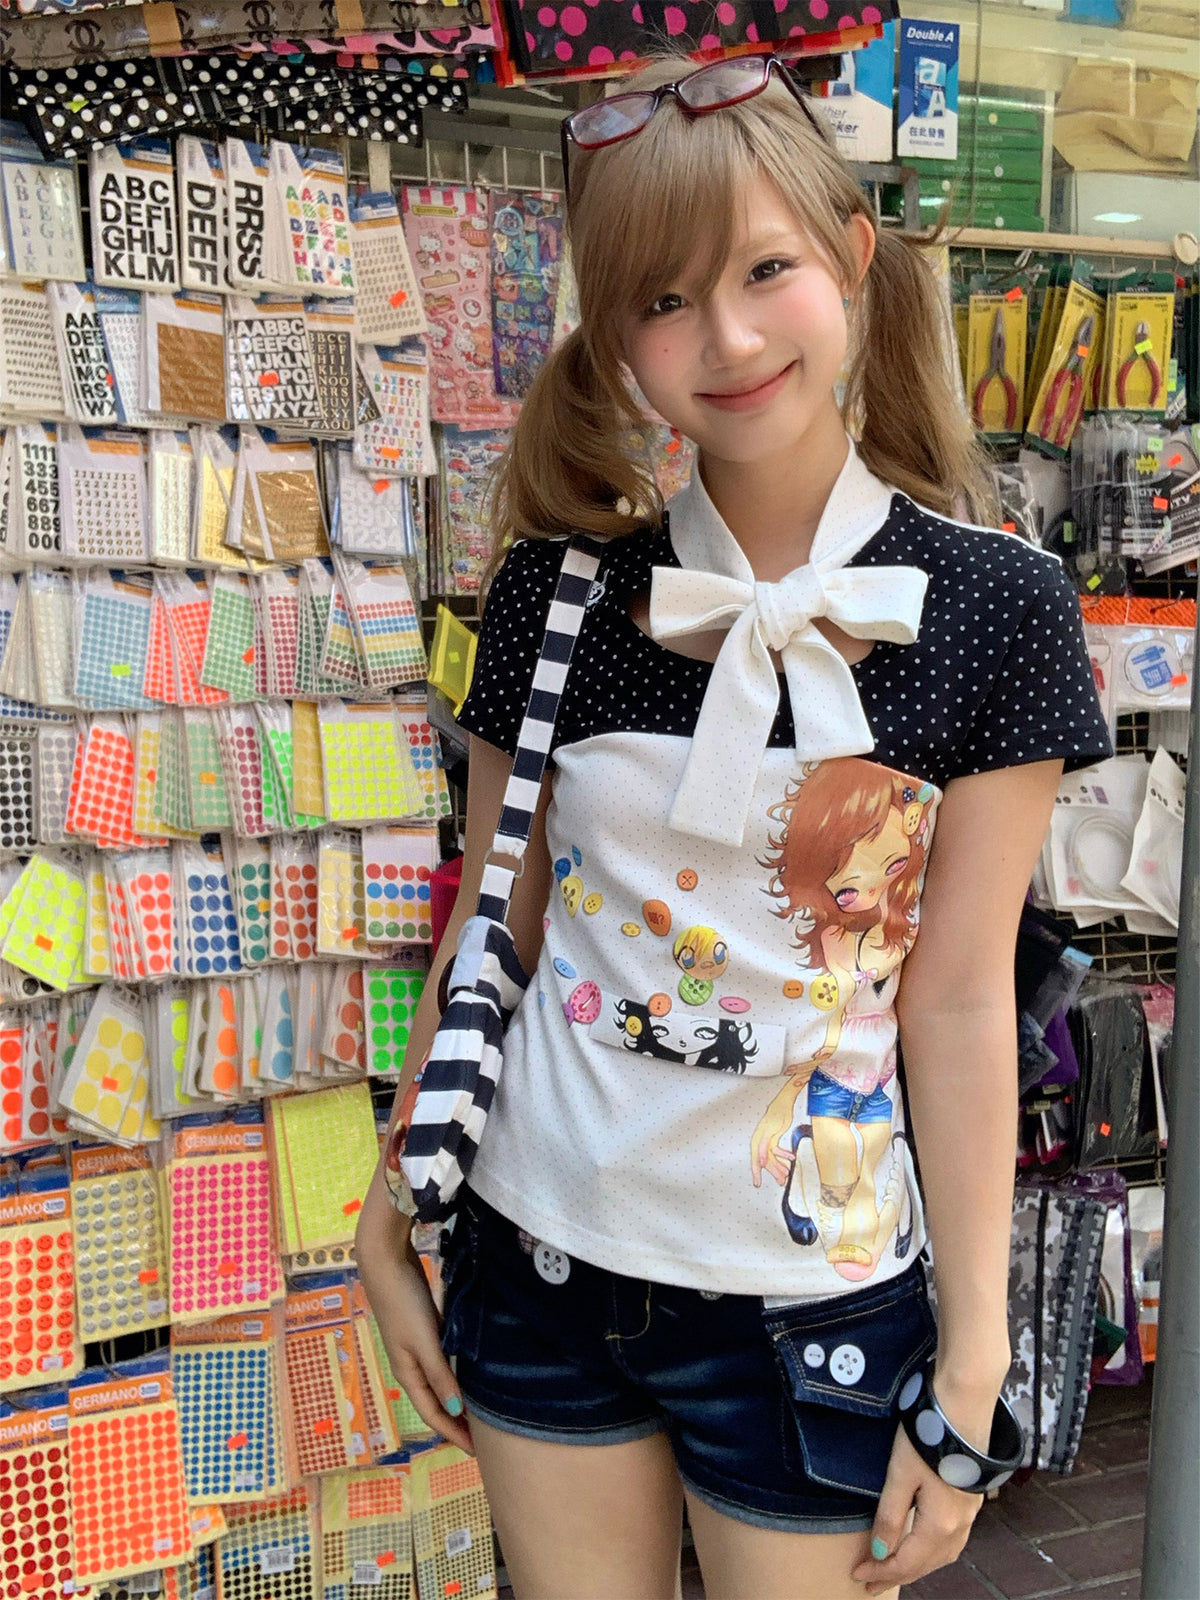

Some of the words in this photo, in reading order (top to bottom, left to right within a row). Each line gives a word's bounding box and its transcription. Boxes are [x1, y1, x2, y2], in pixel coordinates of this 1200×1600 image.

[906, 26, 944, 41] Double
[944, 31, 954, 43] A
[104, 251, 176, 284] KLM
[184, 1132, 242, 1149] GERMANO
[0, 1203, 46, 1221] MANO
[72, 1386, 138, 1411] GERMANO
